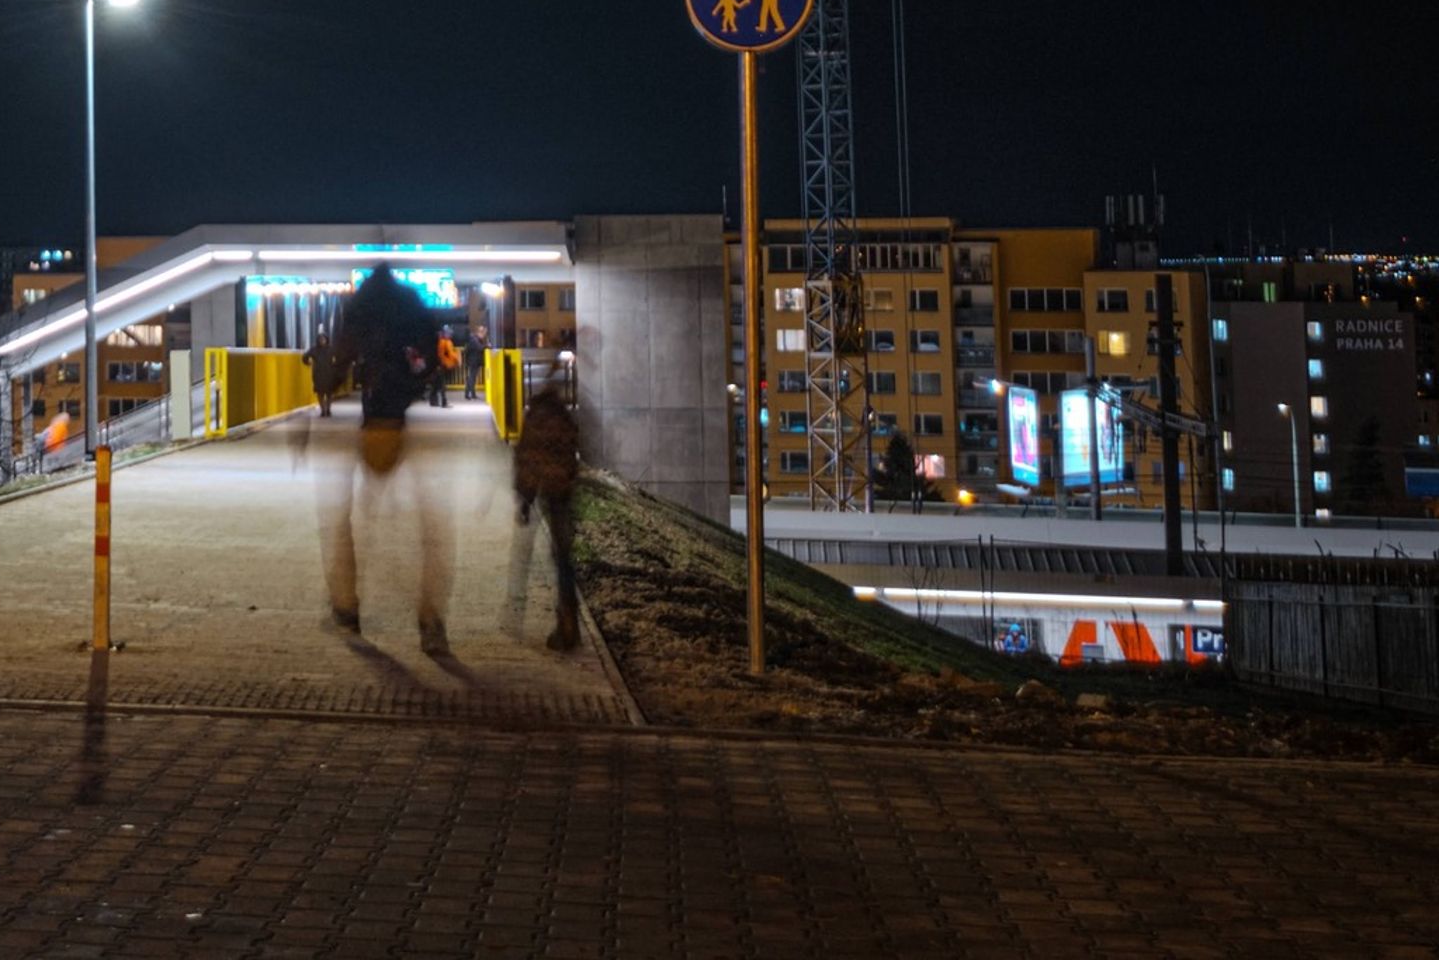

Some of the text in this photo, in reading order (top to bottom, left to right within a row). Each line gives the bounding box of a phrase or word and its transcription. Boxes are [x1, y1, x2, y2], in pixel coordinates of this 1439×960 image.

[1335, 320, 1403, 333] RADNICE
[1336, 338, 1404, 351] PRAHA 14
